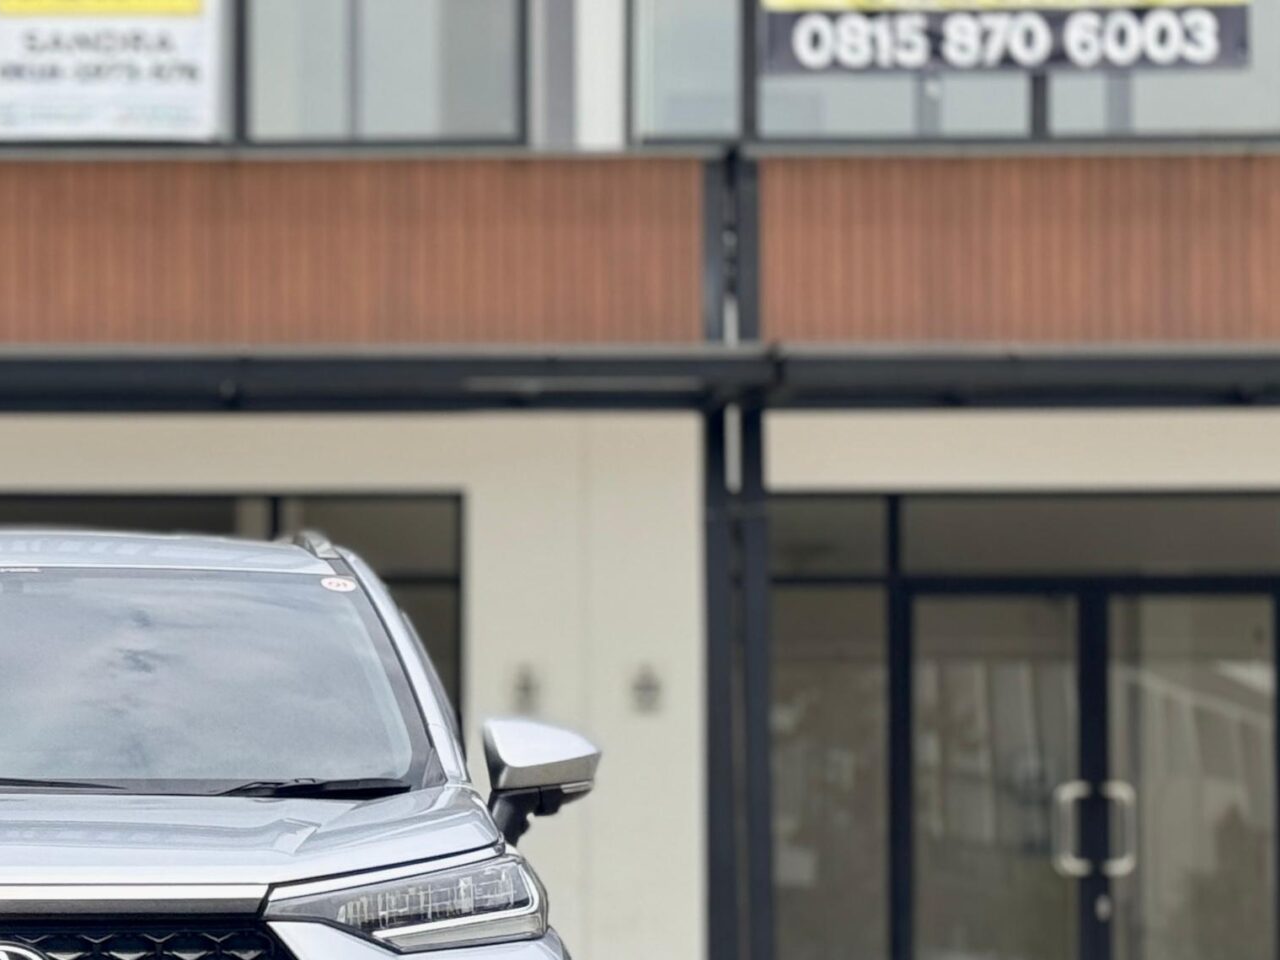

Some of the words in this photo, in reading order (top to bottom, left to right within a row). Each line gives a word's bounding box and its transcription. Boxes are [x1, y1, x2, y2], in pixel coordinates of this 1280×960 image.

[792, 13, 929, 68] 0815
[941, 12, 1053, 67] 870
[1063, 9, 1220, 66] 6003
